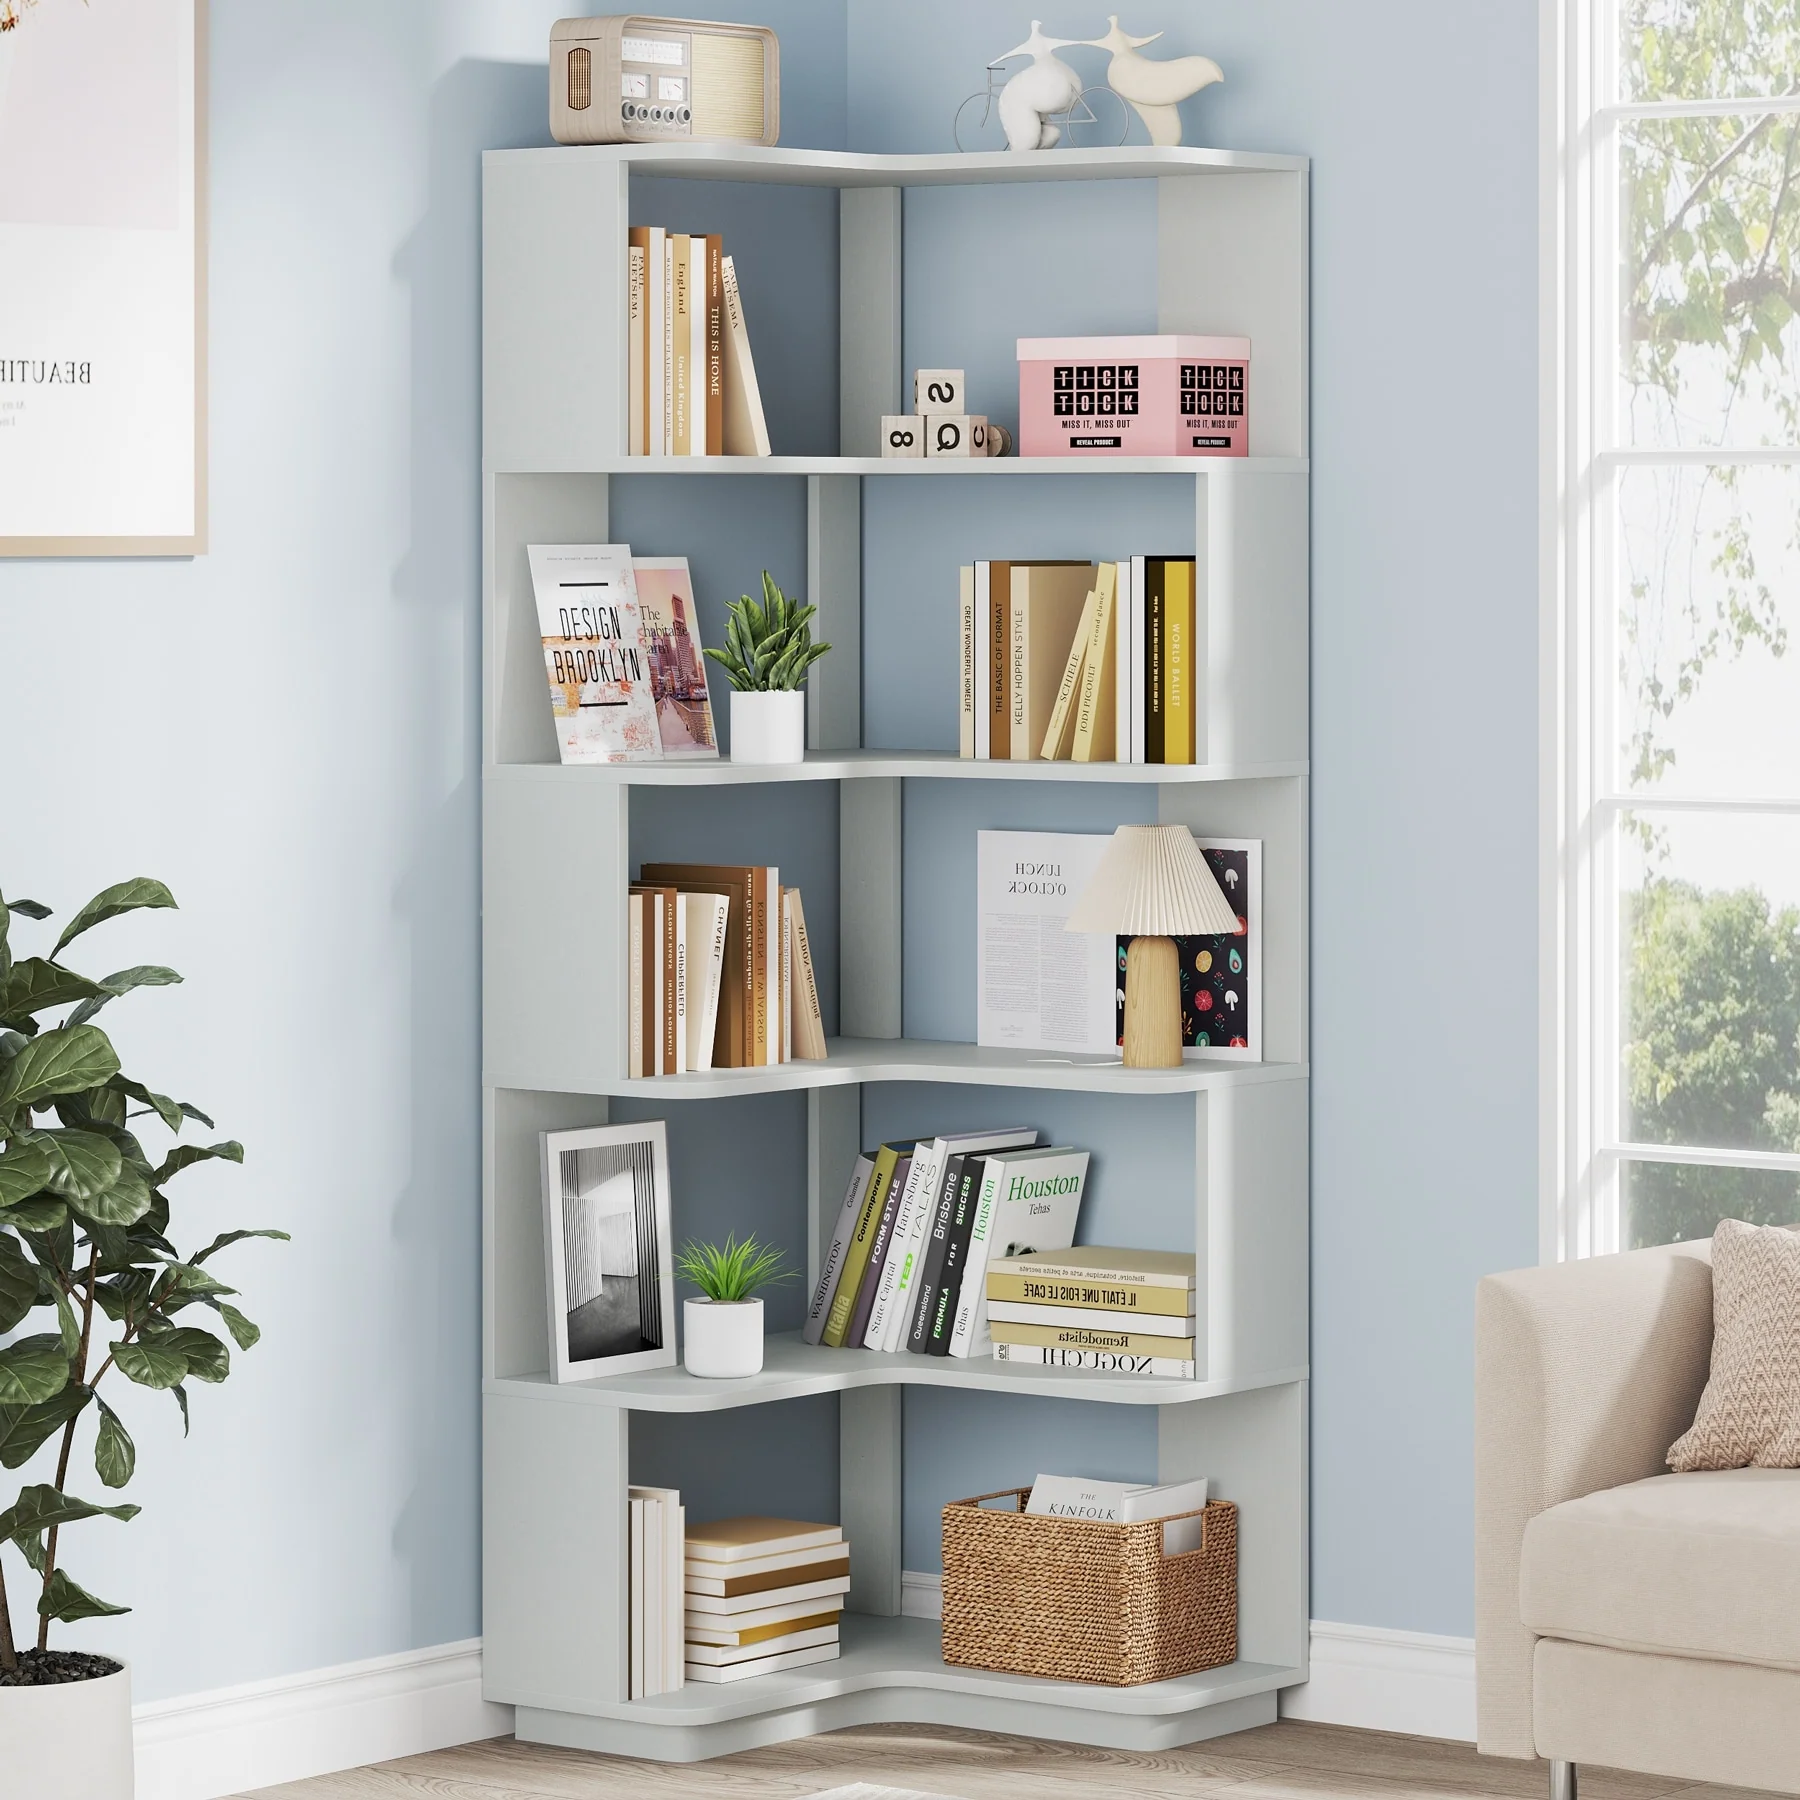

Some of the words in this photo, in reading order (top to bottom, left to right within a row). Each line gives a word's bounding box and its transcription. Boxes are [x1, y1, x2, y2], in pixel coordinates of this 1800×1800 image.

[677, 263, 686, 315] England
[722, 267, 738, 330] SIETSEMA
[711, 306, 719, 336] THIS
[711, 340, 719, 352] IS
[711, 356, 719, 396] HOME
[1059, 369, 1134, 388] TICK
[1184, 369, 1240, 387] TICK
[677, 392, 685, 437] Kingdom
[1059, 394, 1134, 412] TOCK
[1184, 394, 1240, 412] TOCK
[1061, 420, 1080, 429] MISS
[1095, 419, 1114, 428] MISS
[1186, 420, 1200, 428] MISS
[1211, 420, 1226, 428] MISS
[1094, 438, 1114, 446] PRODUCT
[640, 605, 660, 620] The
[1097, 591, 1105, 618] glance
[559, 606, 622, 641] DESIGN
[1014, 610, 1022, 642] STYLE
[1093, 619, 1101, 646] second
[996, 647, 1003, 660] OF
[1172, 624, 1180, 664] WORLD
[553, 648, 641, 684] BROOKLYN
[1014, 646, 1022, 688] HOPPEN
[1060, 653, 1080, 702] SCHIELE
[1083, 664, 1096, 707] PICOULT
[1172, 668, 1180, 707] BALLET
[1014, 692, 1022, 725] KELLY
[1080, 710, 1090, 733] JODI
[1007, 1174, 1079, 1202] Houston
[871, 1224, 888, 1264] FORM
[883, 1178, 900, 1222] STYLE
[973, 1178, 996, 1242] Houston
[1028, 1203, 1050, 1216] Tehas
[899, 1252, 914, 1291] TED
[912, 1163, 937, 1240] TALKS
[811, 1239, 842, 1320] WASHINGTON
[847, 1176, 860, 1208] Columbia
[828, 1294, 850, 1336] Italia
[857, 1172, 883, 1243] Contemporan
[872, 1305, 885, 1334] State
[880, 1261, 896, 1302] Capital
[894, 1160, 926, 1239] Harrisburg
[914, 1284, 932, 1340] Queensland
[934, 1172, 958, 1240] Brisbane
[932, 1287, 950, 1339] FORMULA
[948, 1242, 958, 1266] FOR
[956, 1174, 972, 1226] SUCCESS
[1049, 1503, 1116, 1521] KINFOLK
